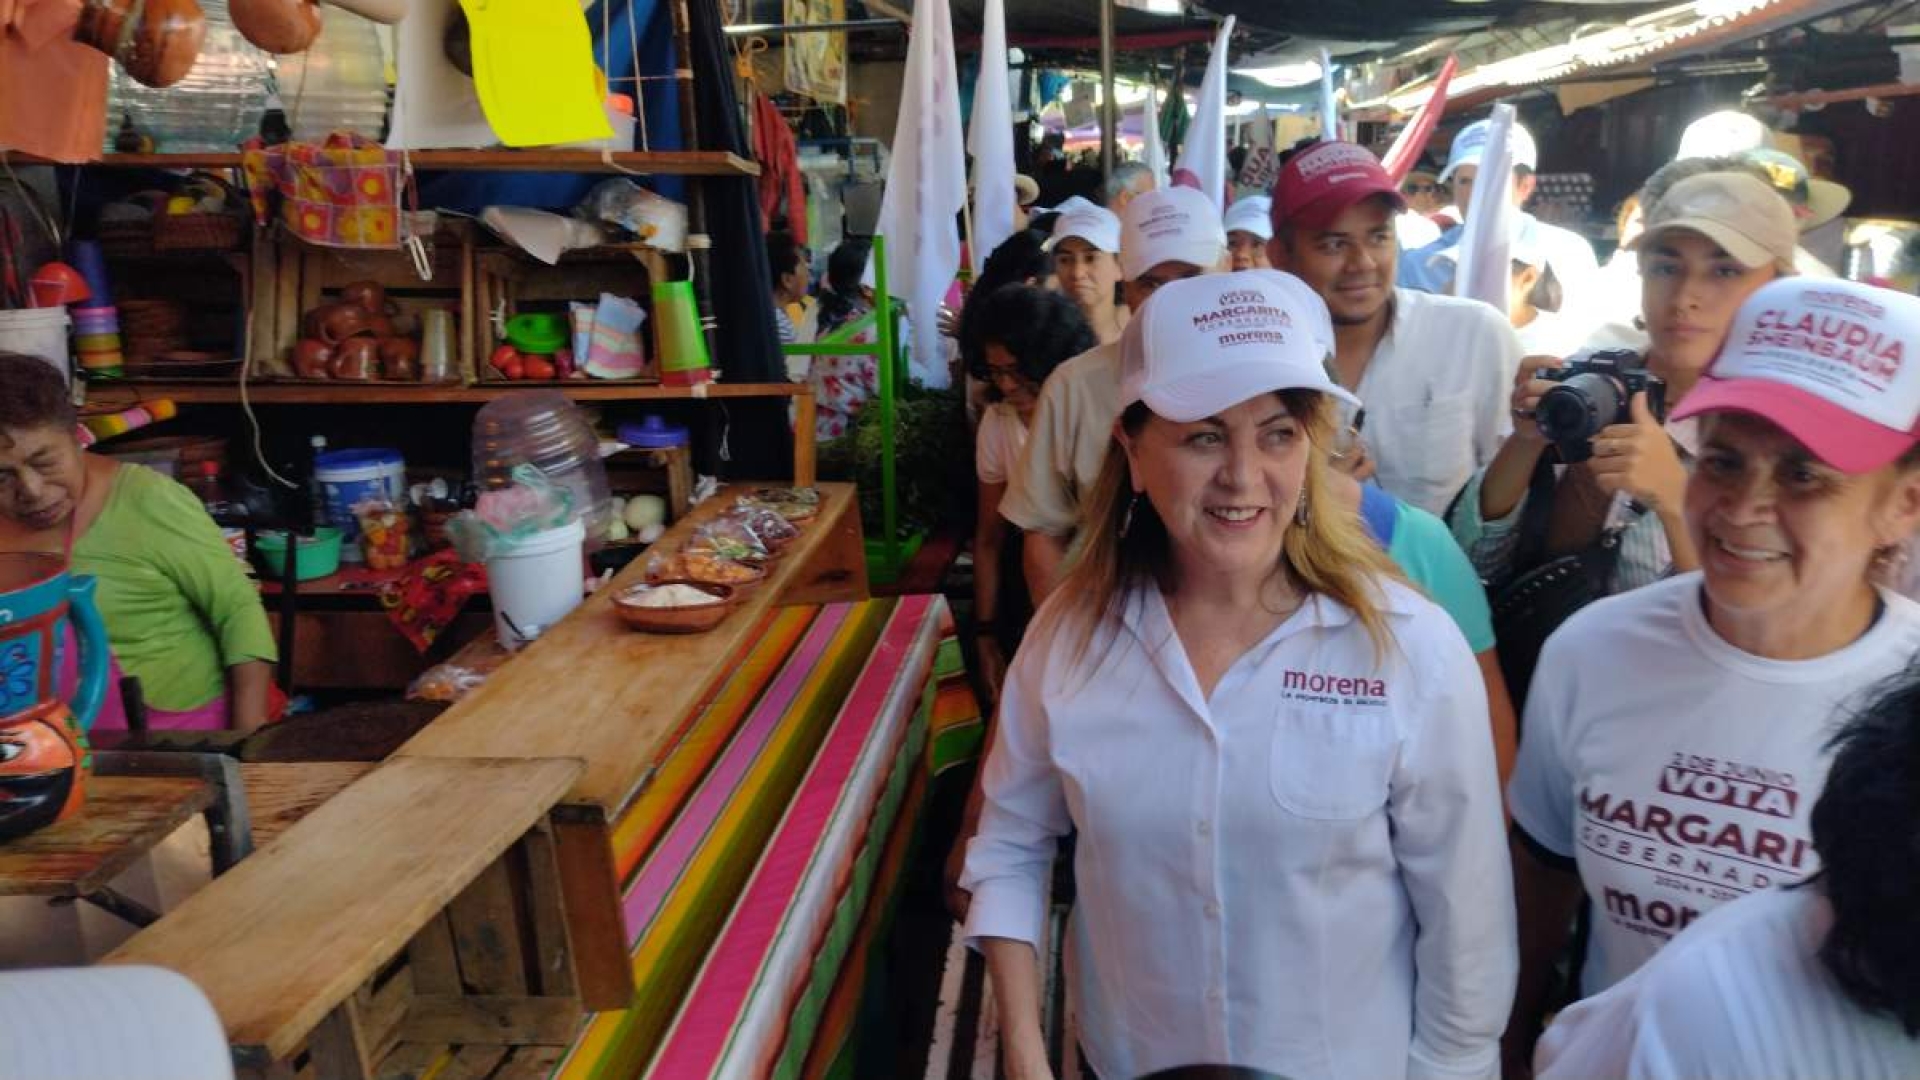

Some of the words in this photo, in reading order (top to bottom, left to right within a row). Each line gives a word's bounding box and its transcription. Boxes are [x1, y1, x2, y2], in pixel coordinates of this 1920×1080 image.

[1193, 306, 1291, 326] MARGARITA
[1218, 330, 1284, 344] morena
[1746, 330, 1899, 382] SHEINBAUM
[1756, 309, 1904, 367] CLAUDIA
[1283, 669, 1386, 697] morena
[1671, 751, 1683, 766] 2
[1689, 754, 1716, 772] DE
[1724, 760, 1795, 787] JUNIO
[1662, 767, 1795, 818] VOTA
[1580, 785, 1811, 869] MARGARI
